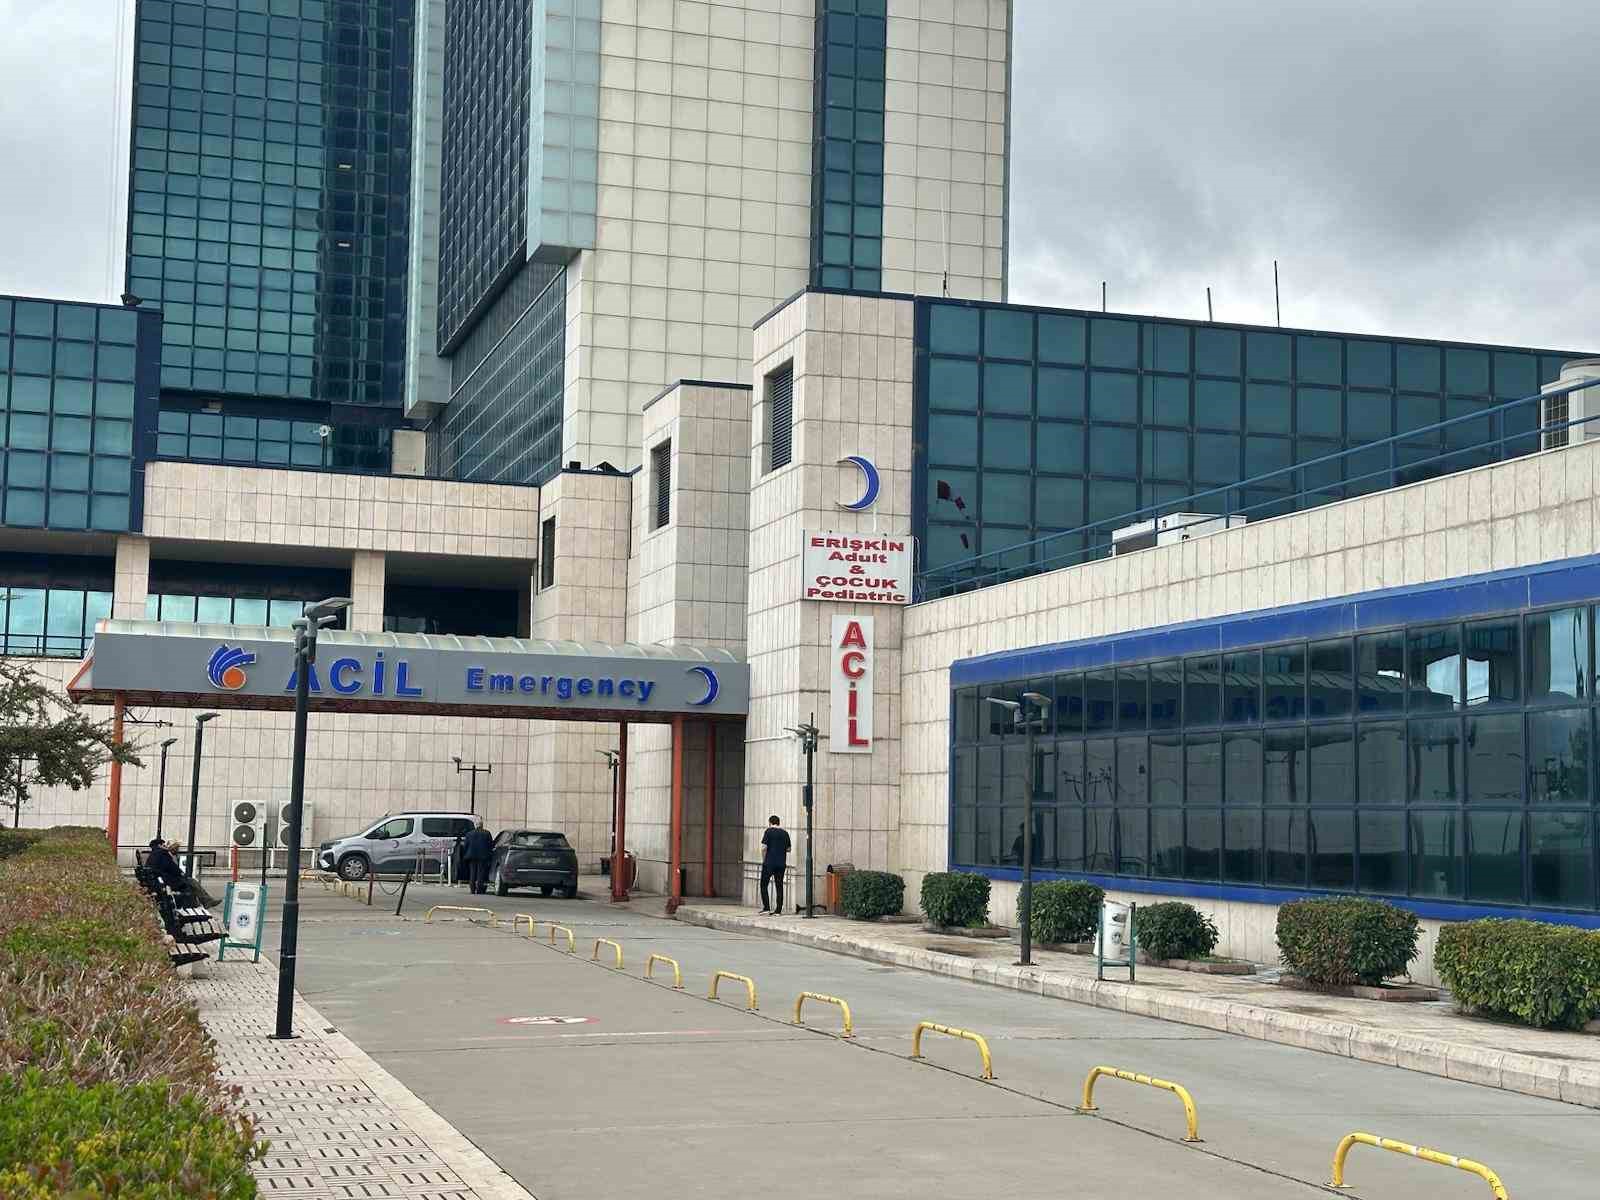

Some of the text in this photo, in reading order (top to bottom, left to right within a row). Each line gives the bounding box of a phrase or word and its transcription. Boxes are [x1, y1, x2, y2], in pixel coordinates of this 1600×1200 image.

[811, 537, 905, 552] ERİŞKİN
[828, 551, 888, 563] Adult
[849, 565, 865, 574] &
[816, 575, 898, 589] ÇOCUK
[807, 588, 905, 602] Pediatric
[466, 667, 656, 702] Emergency
[841, 621, 869, 747] ACİL
